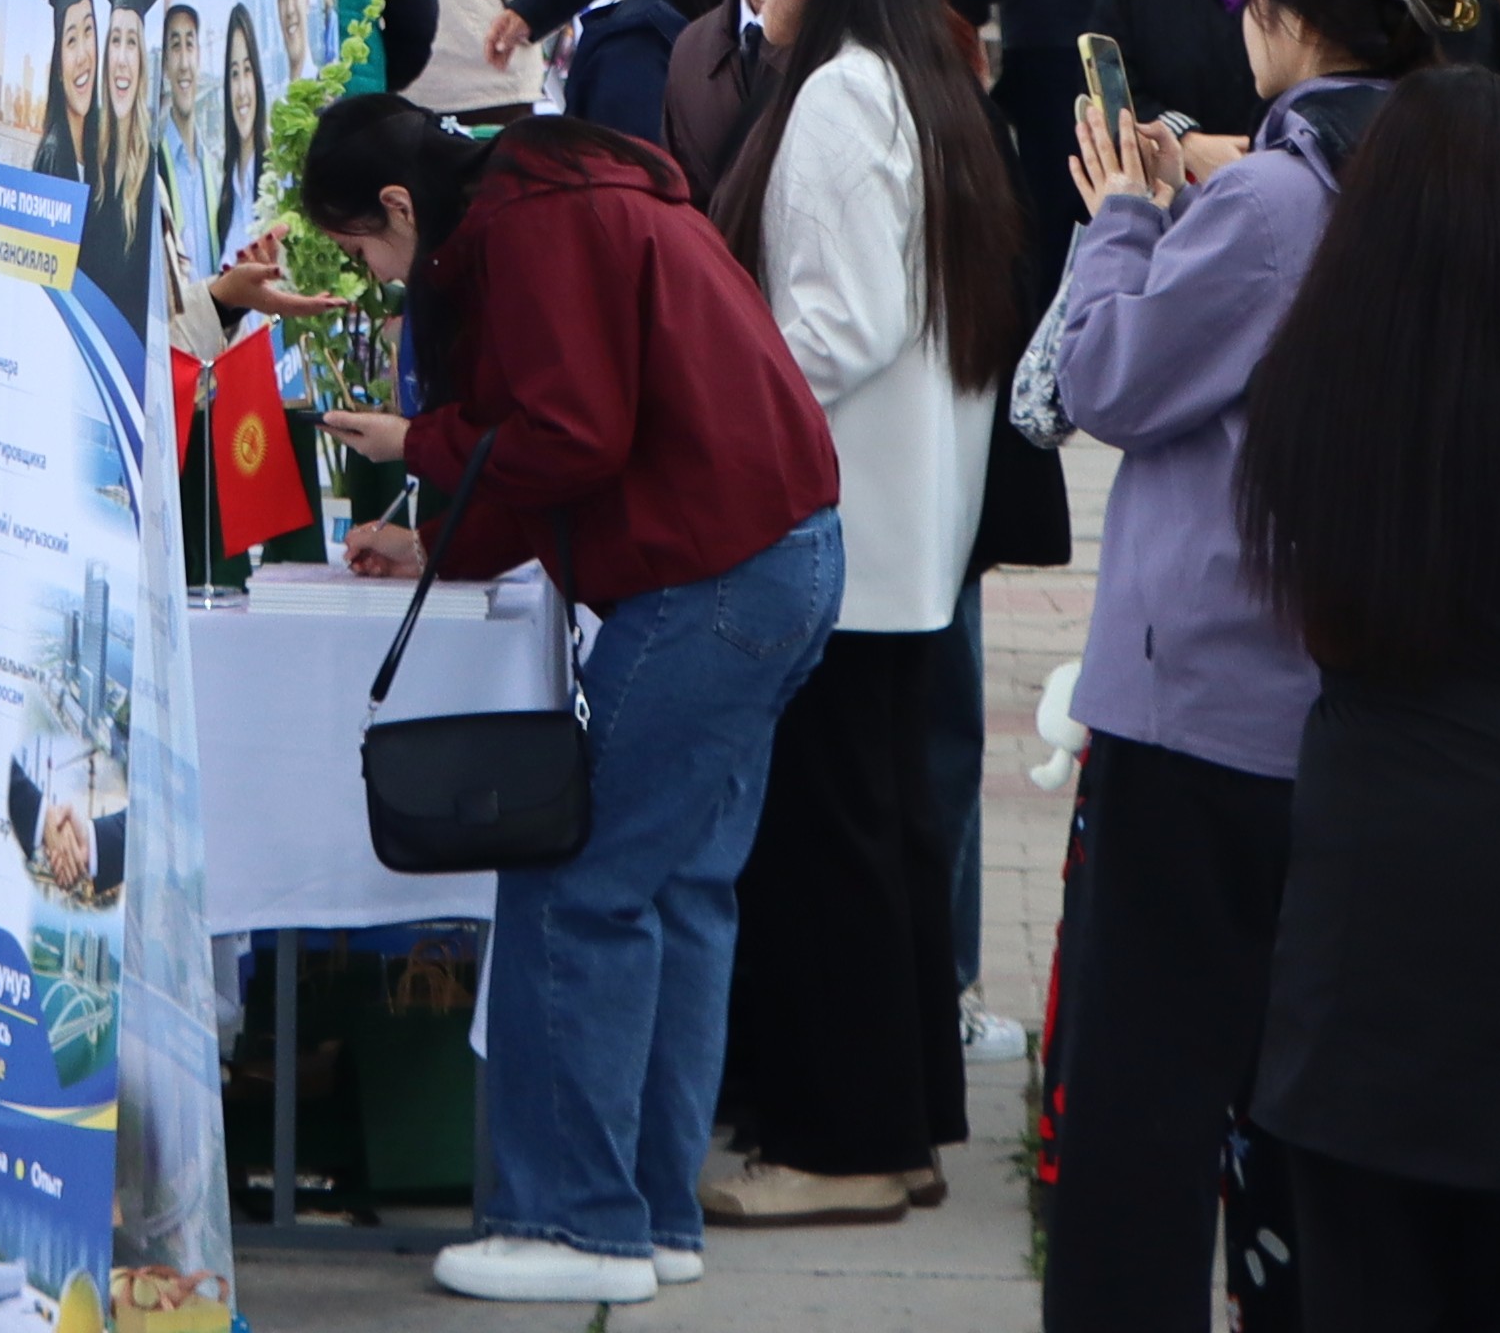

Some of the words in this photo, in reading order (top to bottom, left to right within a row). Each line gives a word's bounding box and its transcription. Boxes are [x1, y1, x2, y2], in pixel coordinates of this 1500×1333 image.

[18, 189, 72, 227] позиции
[13, 523, 70, 554] кыргызский
[29, 1161, 64, 1200] Опыт
